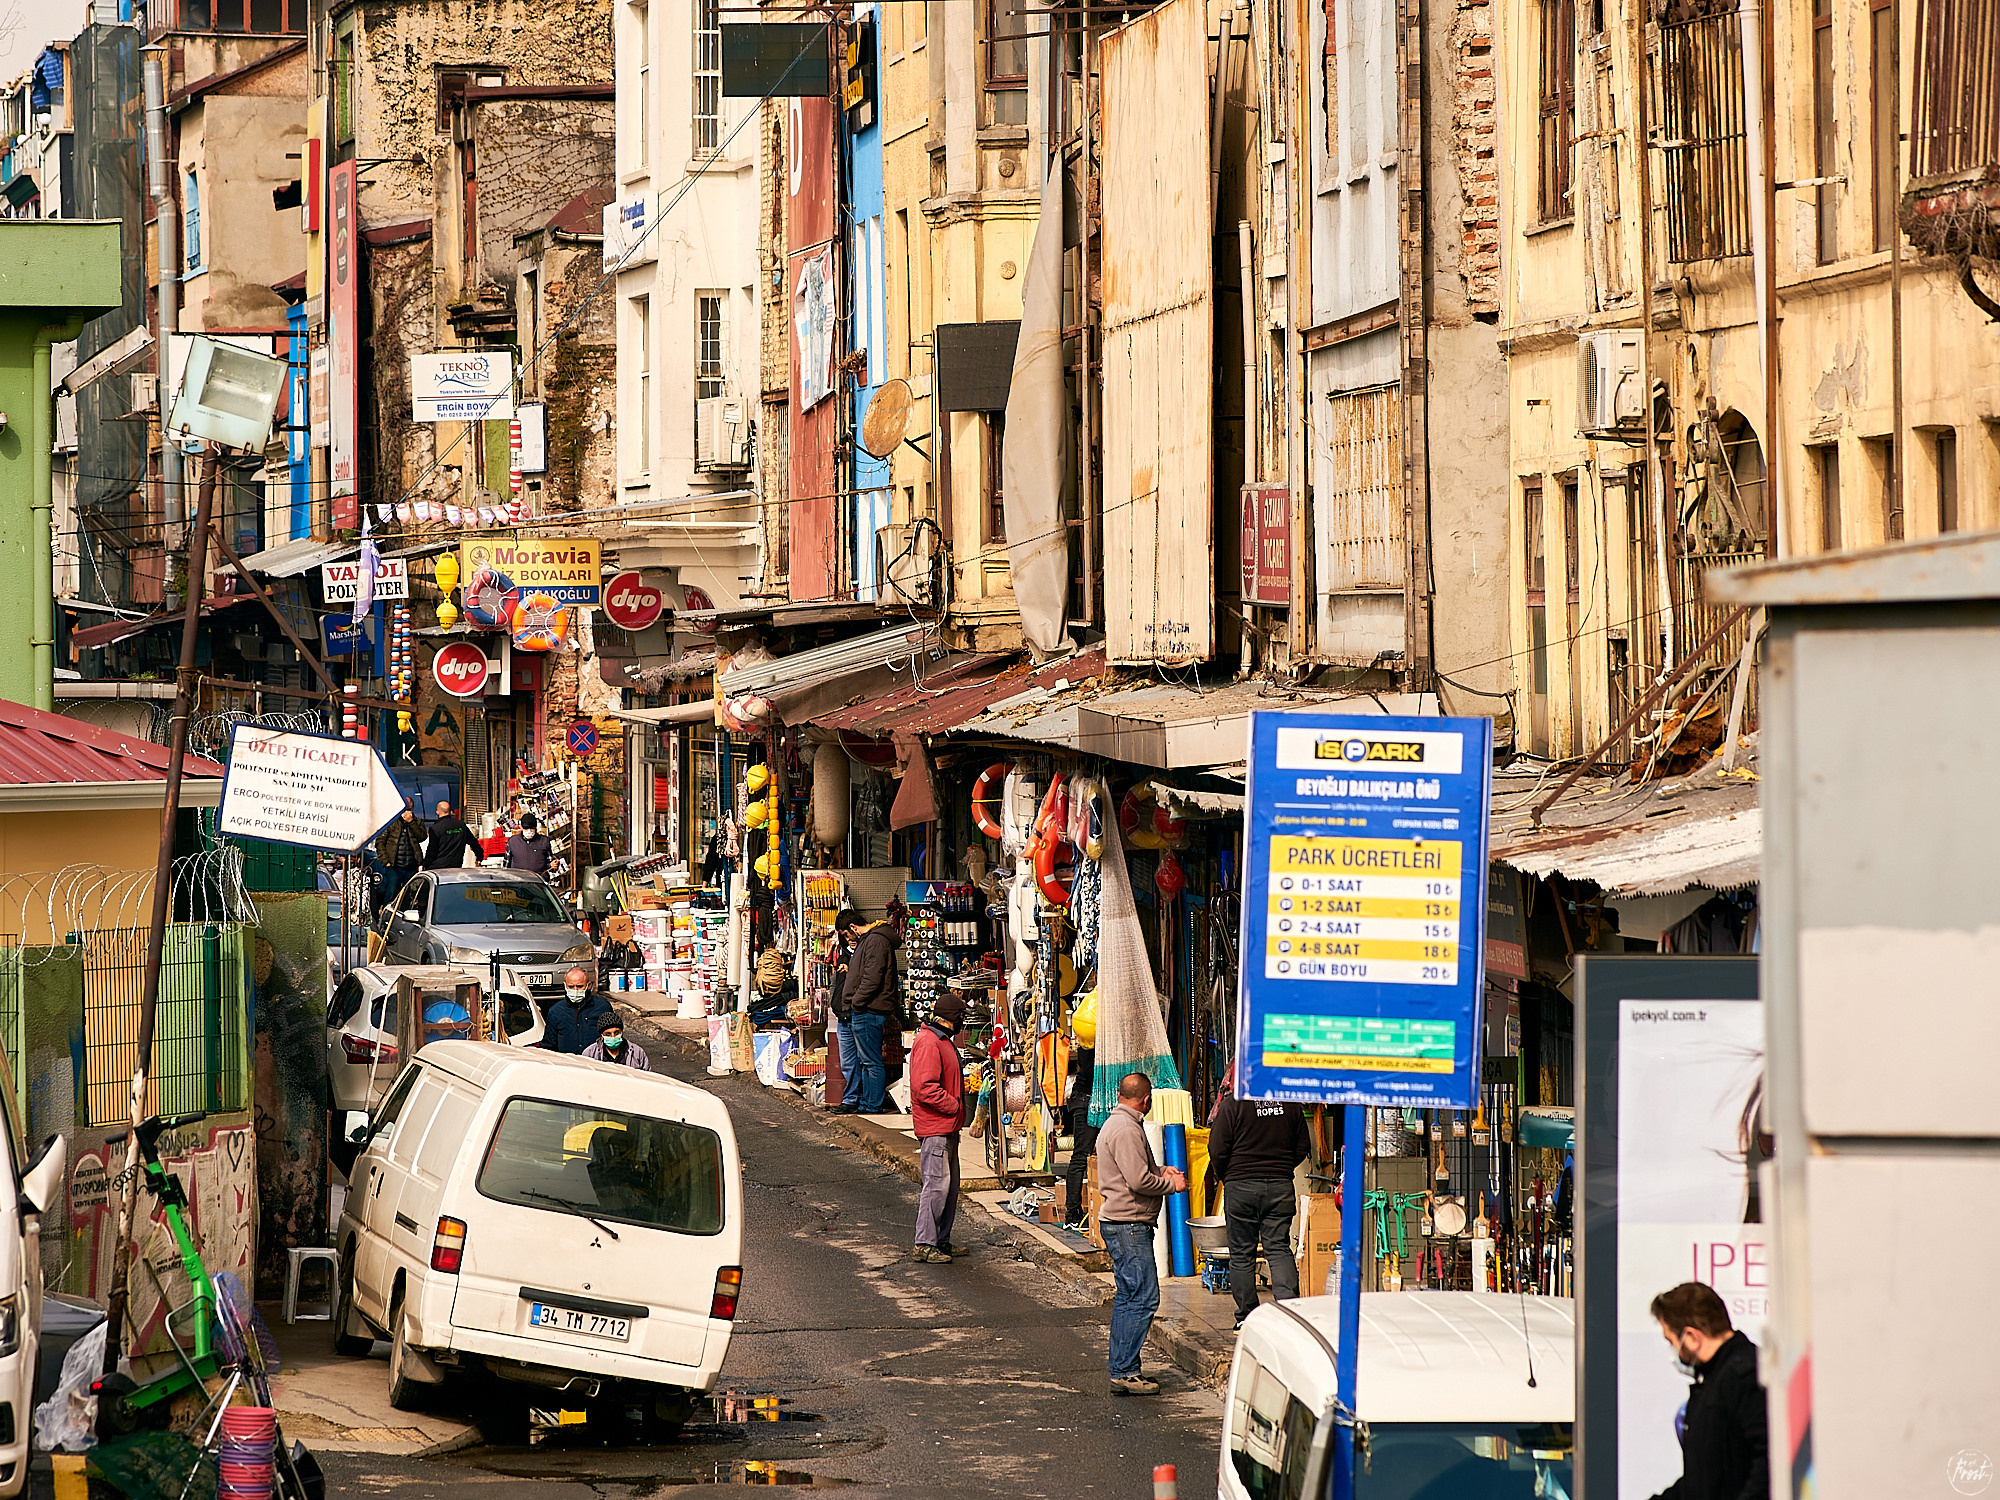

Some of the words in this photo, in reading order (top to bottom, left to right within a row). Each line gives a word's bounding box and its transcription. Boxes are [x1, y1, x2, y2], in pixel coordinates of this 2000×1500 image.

[440, 362, 483, 372] TEKNO
[437, 402, 464, 411] ERGİN
[467, 403, 489, 411] BOYA
[495, 547, 592, 565] Moravia
[1263, 530, 1285, 569] TİCARET
[520, 570, 592, 581] BOYALARI
[611, 588, 657, 613] dyo
[440, 658, 483, 680] dyo
[248, 737, 288, 758] ÖZER
[292, 745, 360, 767] TİCARET
[233, 762, 279, 775] POLYESTER
[1296, 774, 1348, 797] BEYOĞLU
[1349, 778, 1415, 802] BALIKÇILAR
[1415, 778, 1441, 800] ÖNÜ
[233, 787, 260, 799] ERCO
[261, 793, 302, 805] POLYESTER
[303, 799, 313, 807] VE
[314, 801, 334, 811] BOYA
[335, 803, 361, 814] VERNİK
[262, 805, 297, 819] YETKİLİ
[298, 811, 329, 824] BAYİSİ
[230, 816, 253, 827] AÇIK
[254, 818, 309, 836] POLYESTER
[310, 828, 356, 842] BULUNUR
[1288, 847, 1335, 866] PARK
[1342, 845, 1442, 870] ÜCRETLERİ
[1302, 878, 1322, 891] 0-1
[1328, 879, 1363, 892] SAAT
[1426, 883, 1441, 895] 10
[1302, 900, 1322, 912] 1-2
[1327, 901, 1362, 913] SAAT
[1425, 904, 1440, 916] 13
[1300, 921, 1322, 933] 2-4
[1326, 922, 1361, 935] SAAT
[1424, 925, 1440, 937] 15
[1299, 942, 1321, 954] 4-8
[1326, 943, 1360, 956] SAAT
[1423, 946, 1439, 958] 18
[1299, 961, 1325, 975] GÜN
[1331, 963, 1367, 977] BOYU
[1422, 967, 1439, 979] 20
[529, 974, 547, 984] 8701
[1631, 1010, 1707, 1024] ipekyol.com.tr
[1256, 1107, 1285, 1117] ROPES
[541, 1308, 558, 1326] 34
[566, 1311, 584, 1330] TM
[589, 1316, 626, 1337] 7712
